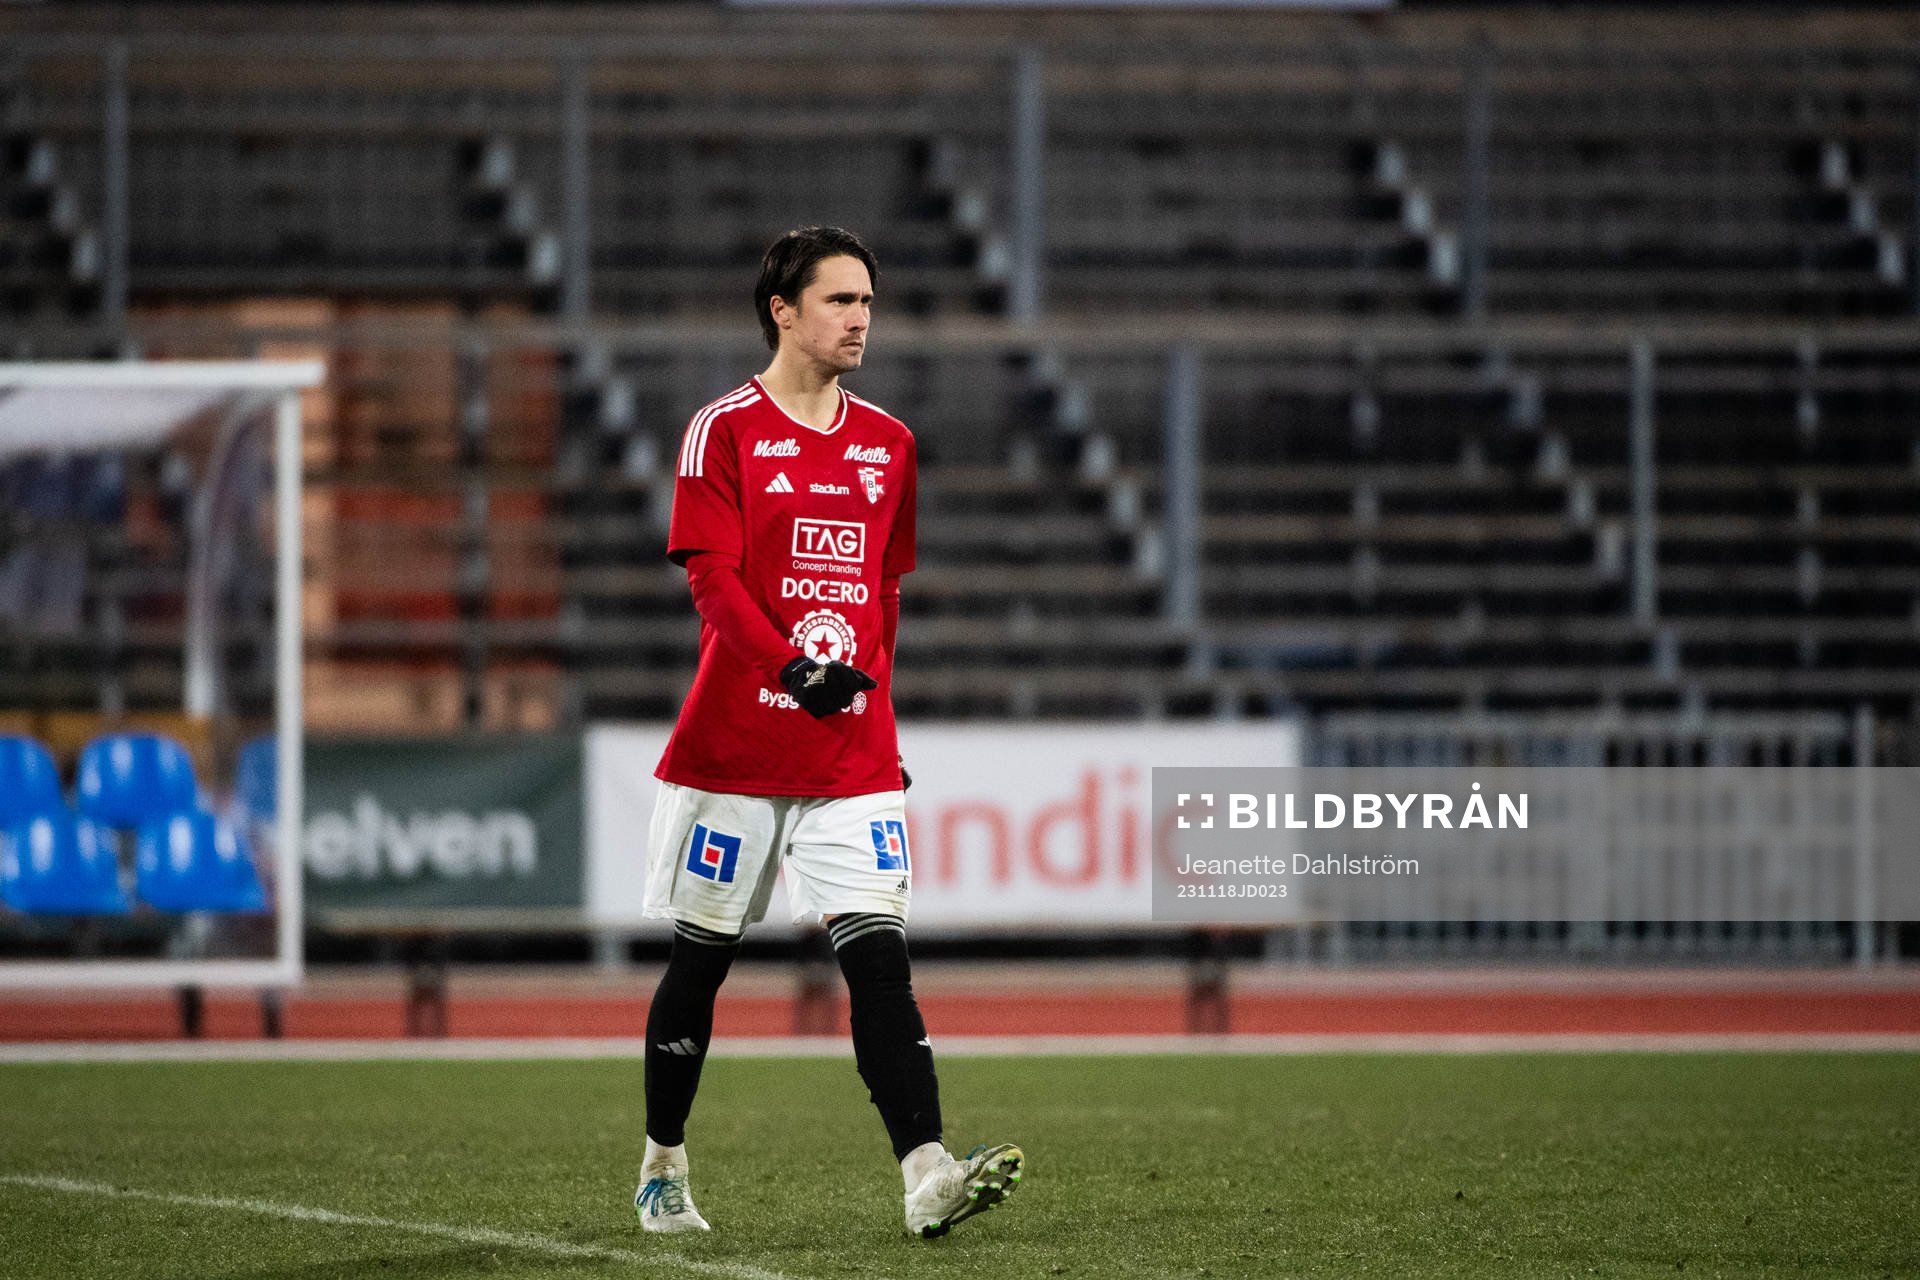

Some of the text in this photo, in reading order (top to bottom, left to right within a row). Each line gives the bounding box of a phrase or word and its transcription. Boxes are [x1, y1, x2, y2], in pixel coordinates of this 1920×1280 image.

[754, 438, 800, 457] Motillo
[844, 444, 891, 464] Motillo
[809, 483, 849, 495] stadium
[801, 526, 858, 554] TAG
[792, 560, 862, 576] Concept branding
[781, 577, 868, 603] DOCERO
